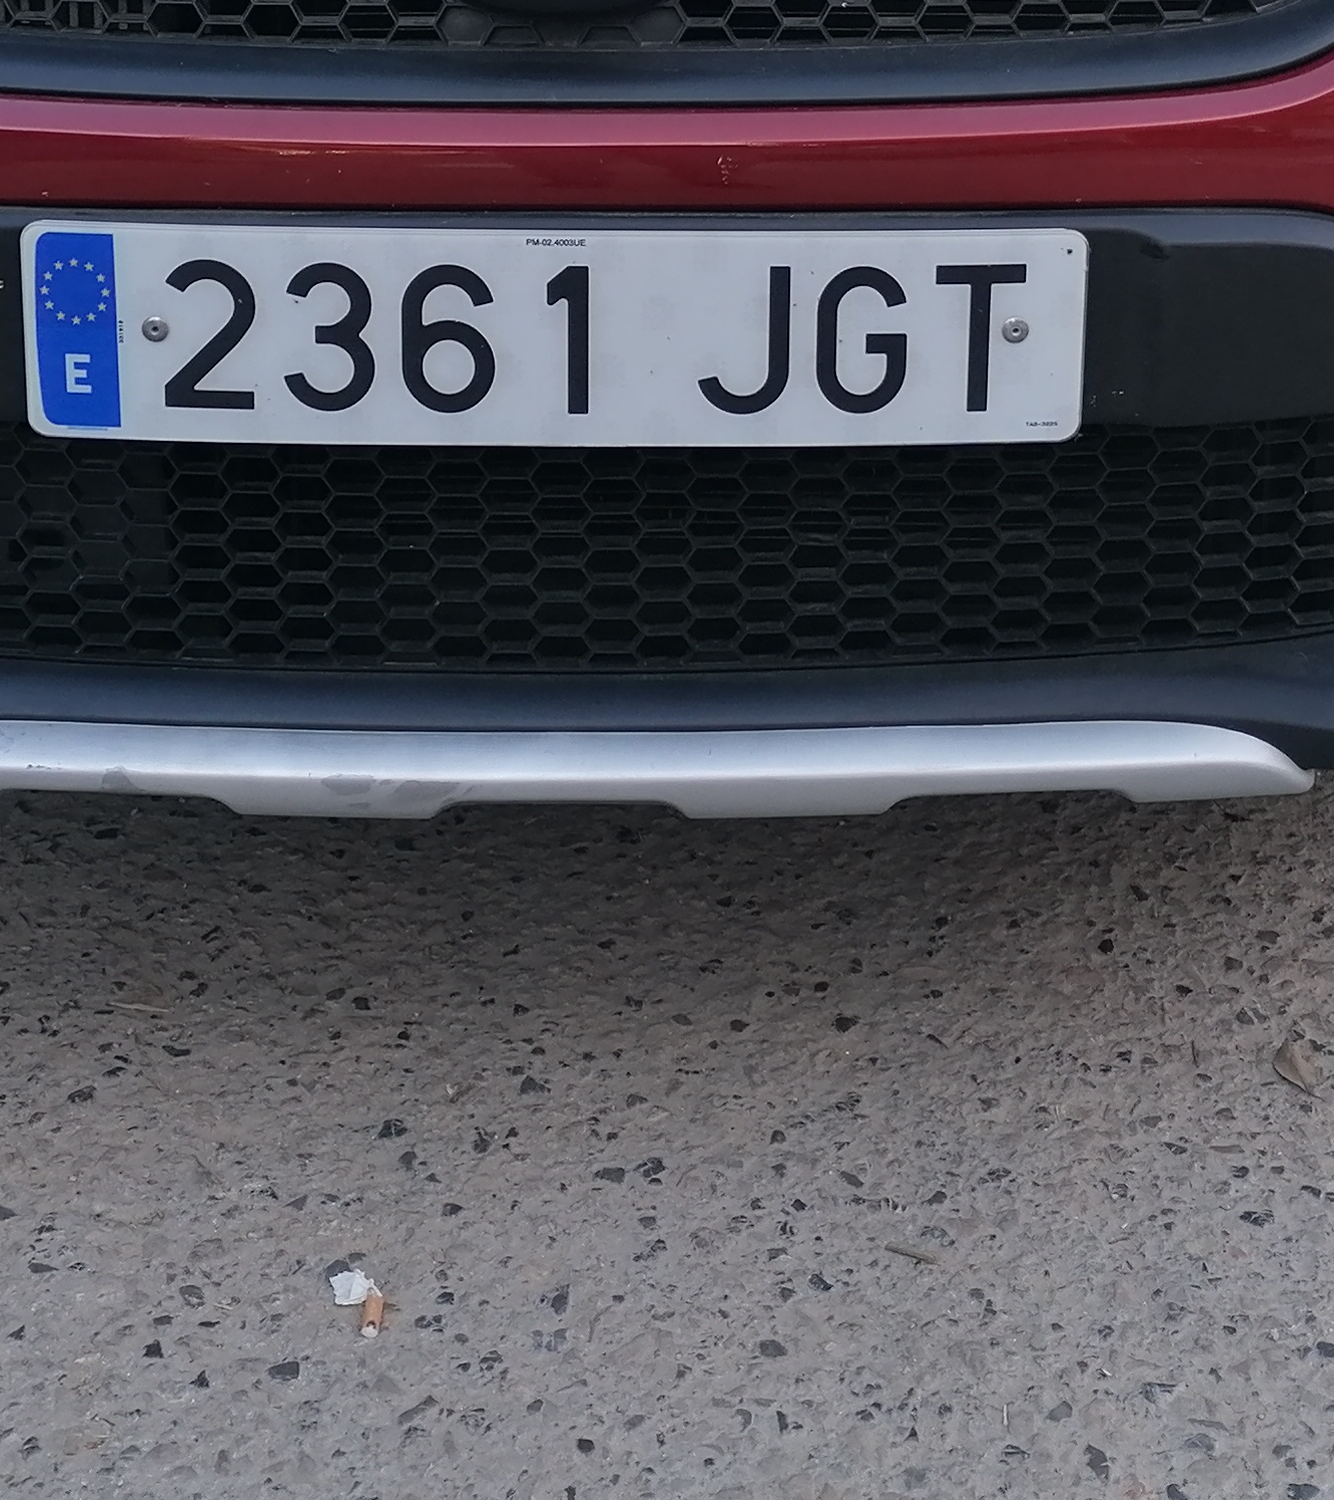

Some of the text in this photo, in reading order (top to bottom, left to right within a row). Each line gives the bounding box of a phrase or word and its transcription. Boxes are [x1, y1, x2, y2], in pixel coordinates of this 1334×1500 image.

[65, 353, 93, 394] E
[164, 258, 1028, 417] 2361 JGT
